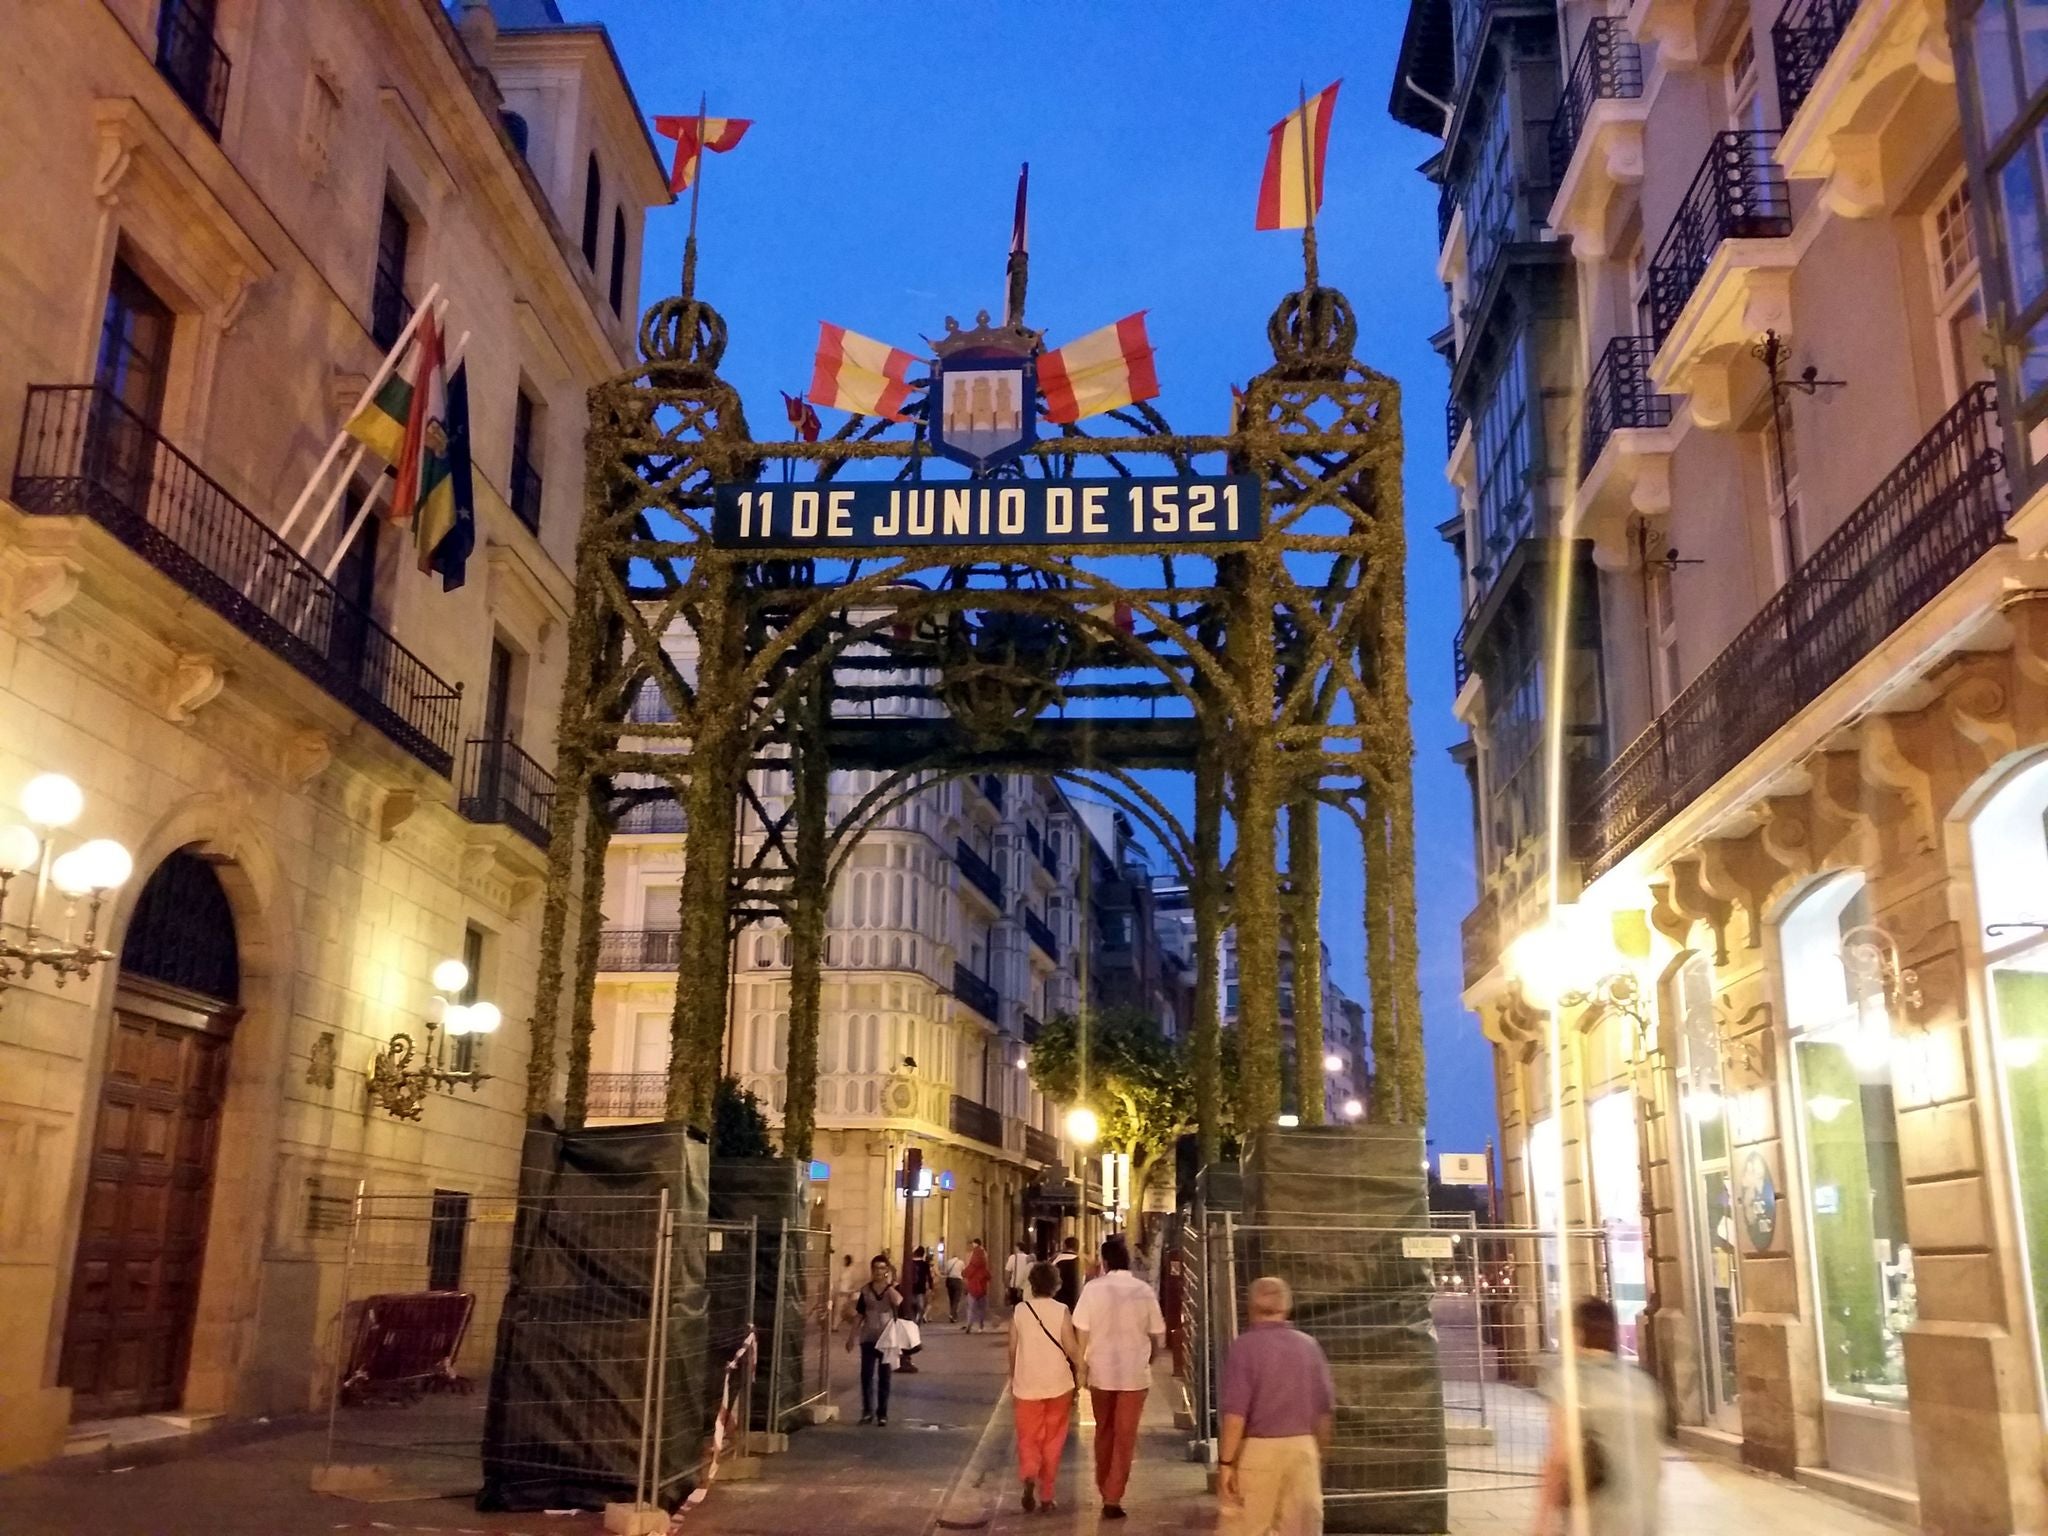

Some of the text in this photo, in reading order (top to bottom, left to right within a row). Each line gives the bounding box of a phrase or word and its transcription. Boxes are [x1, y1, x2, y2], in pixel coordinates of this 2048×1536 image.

[737, 484, 1239, 538] 11 DE JUNIO DE 1521
